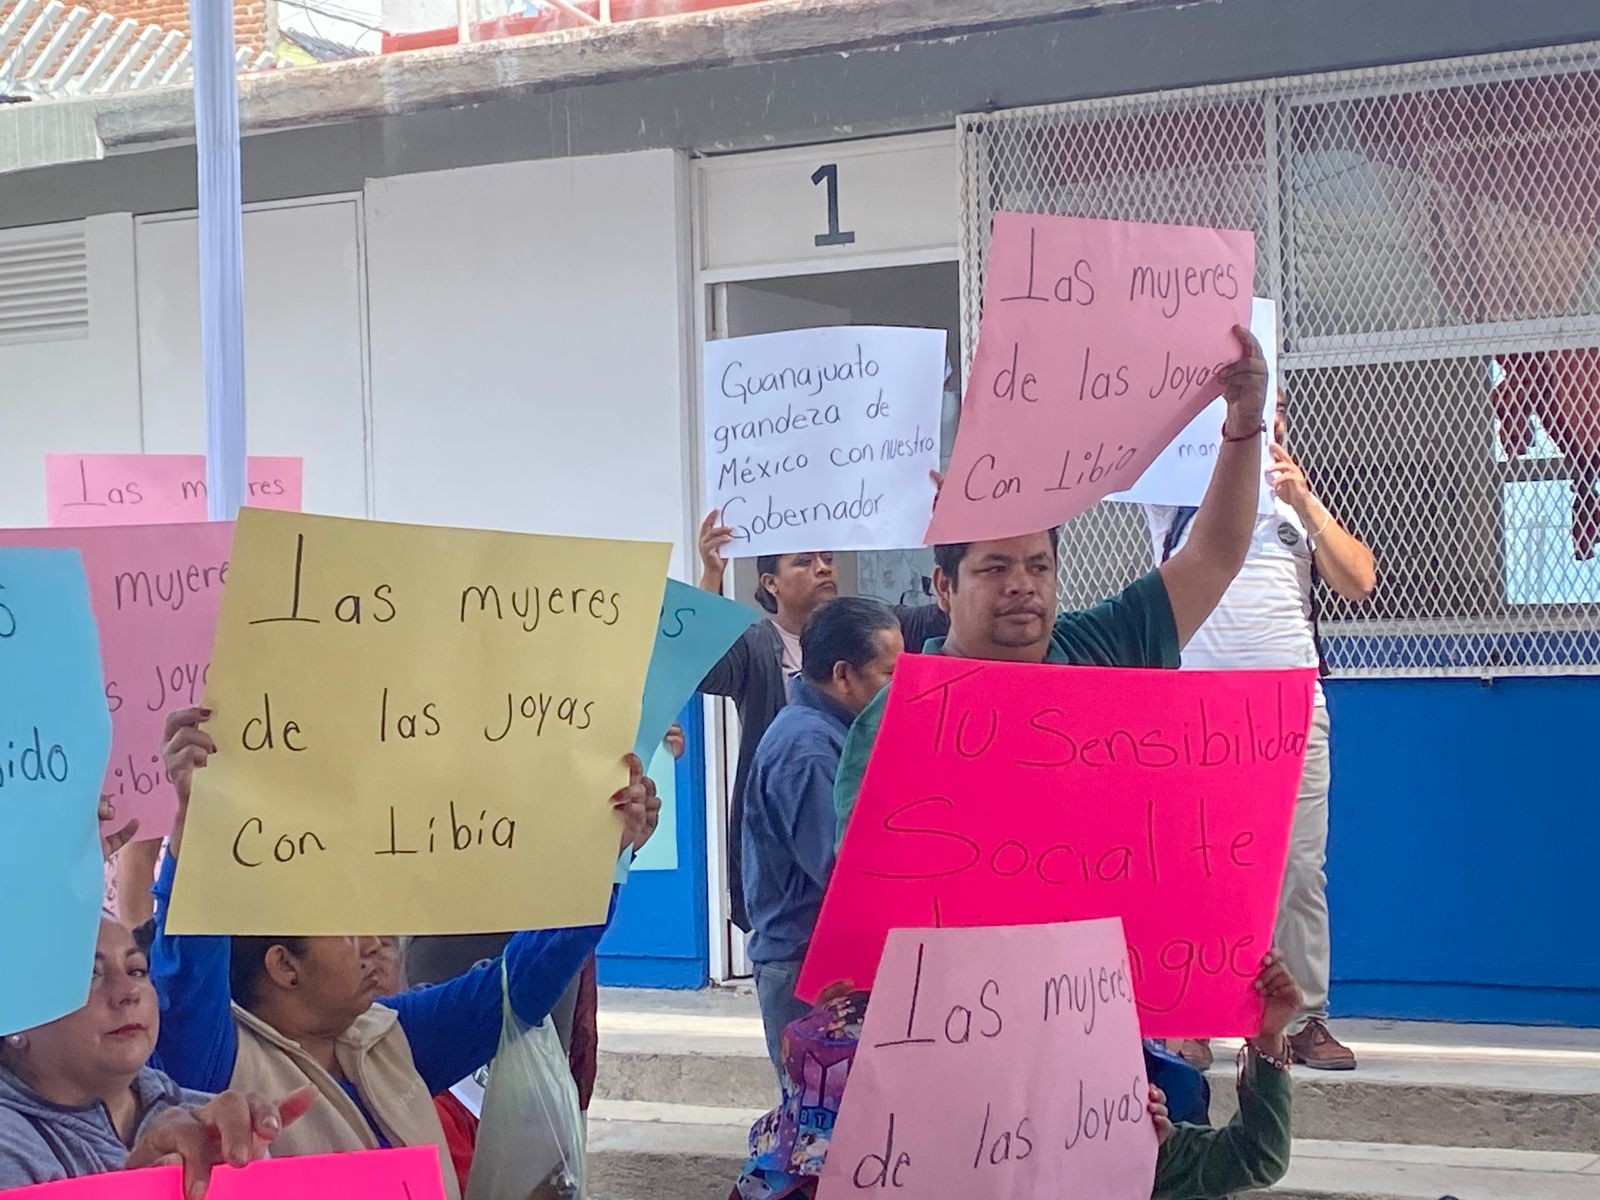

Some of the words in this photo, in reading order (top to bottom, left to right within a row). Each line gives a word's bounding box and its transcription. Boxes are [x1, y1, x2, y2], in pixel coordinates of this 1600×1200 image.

[810, 163, 855, 247] 1
[1000, 227, 1095, 306] Las
[1129, 262, 1239, 319] mujeres
[721, 343, 879, 404] Guanajuato
[993, 342, 1040, 402] de
[1079, 347, 1130, 401] las
[714, 403, 841, 454] grandeza
[866, 388, 890, 419] de
[63, 460, 143, 507] Las
[182, 480, 285, 500] mres
[718, 453, 809, 491] México
[880, 425, 934, 460] nuestro
[1044, 442, 1137, 491] Libia
[720, 477, 884, 544] Gobernador
[114, 561, 229, 611] mujere
[248, 533, 396, 625] Las
[460, 584, 620, 632] mujeres
[147, 663, 211, 712] Joy
[242, 693, 308, 752] de
[380, 688, 441, 742] las
[109, 754, 173, 797] ibi
[861, 796, 1158, 885] Social
[1190, 796, 1255, 879] te
[874, 943, 1002, 1048] Las
[1044, 959, 1132, 1035] mujeres
[853, 1112, 911, 1190] de
[974, 1103, 1033, 1169] las
